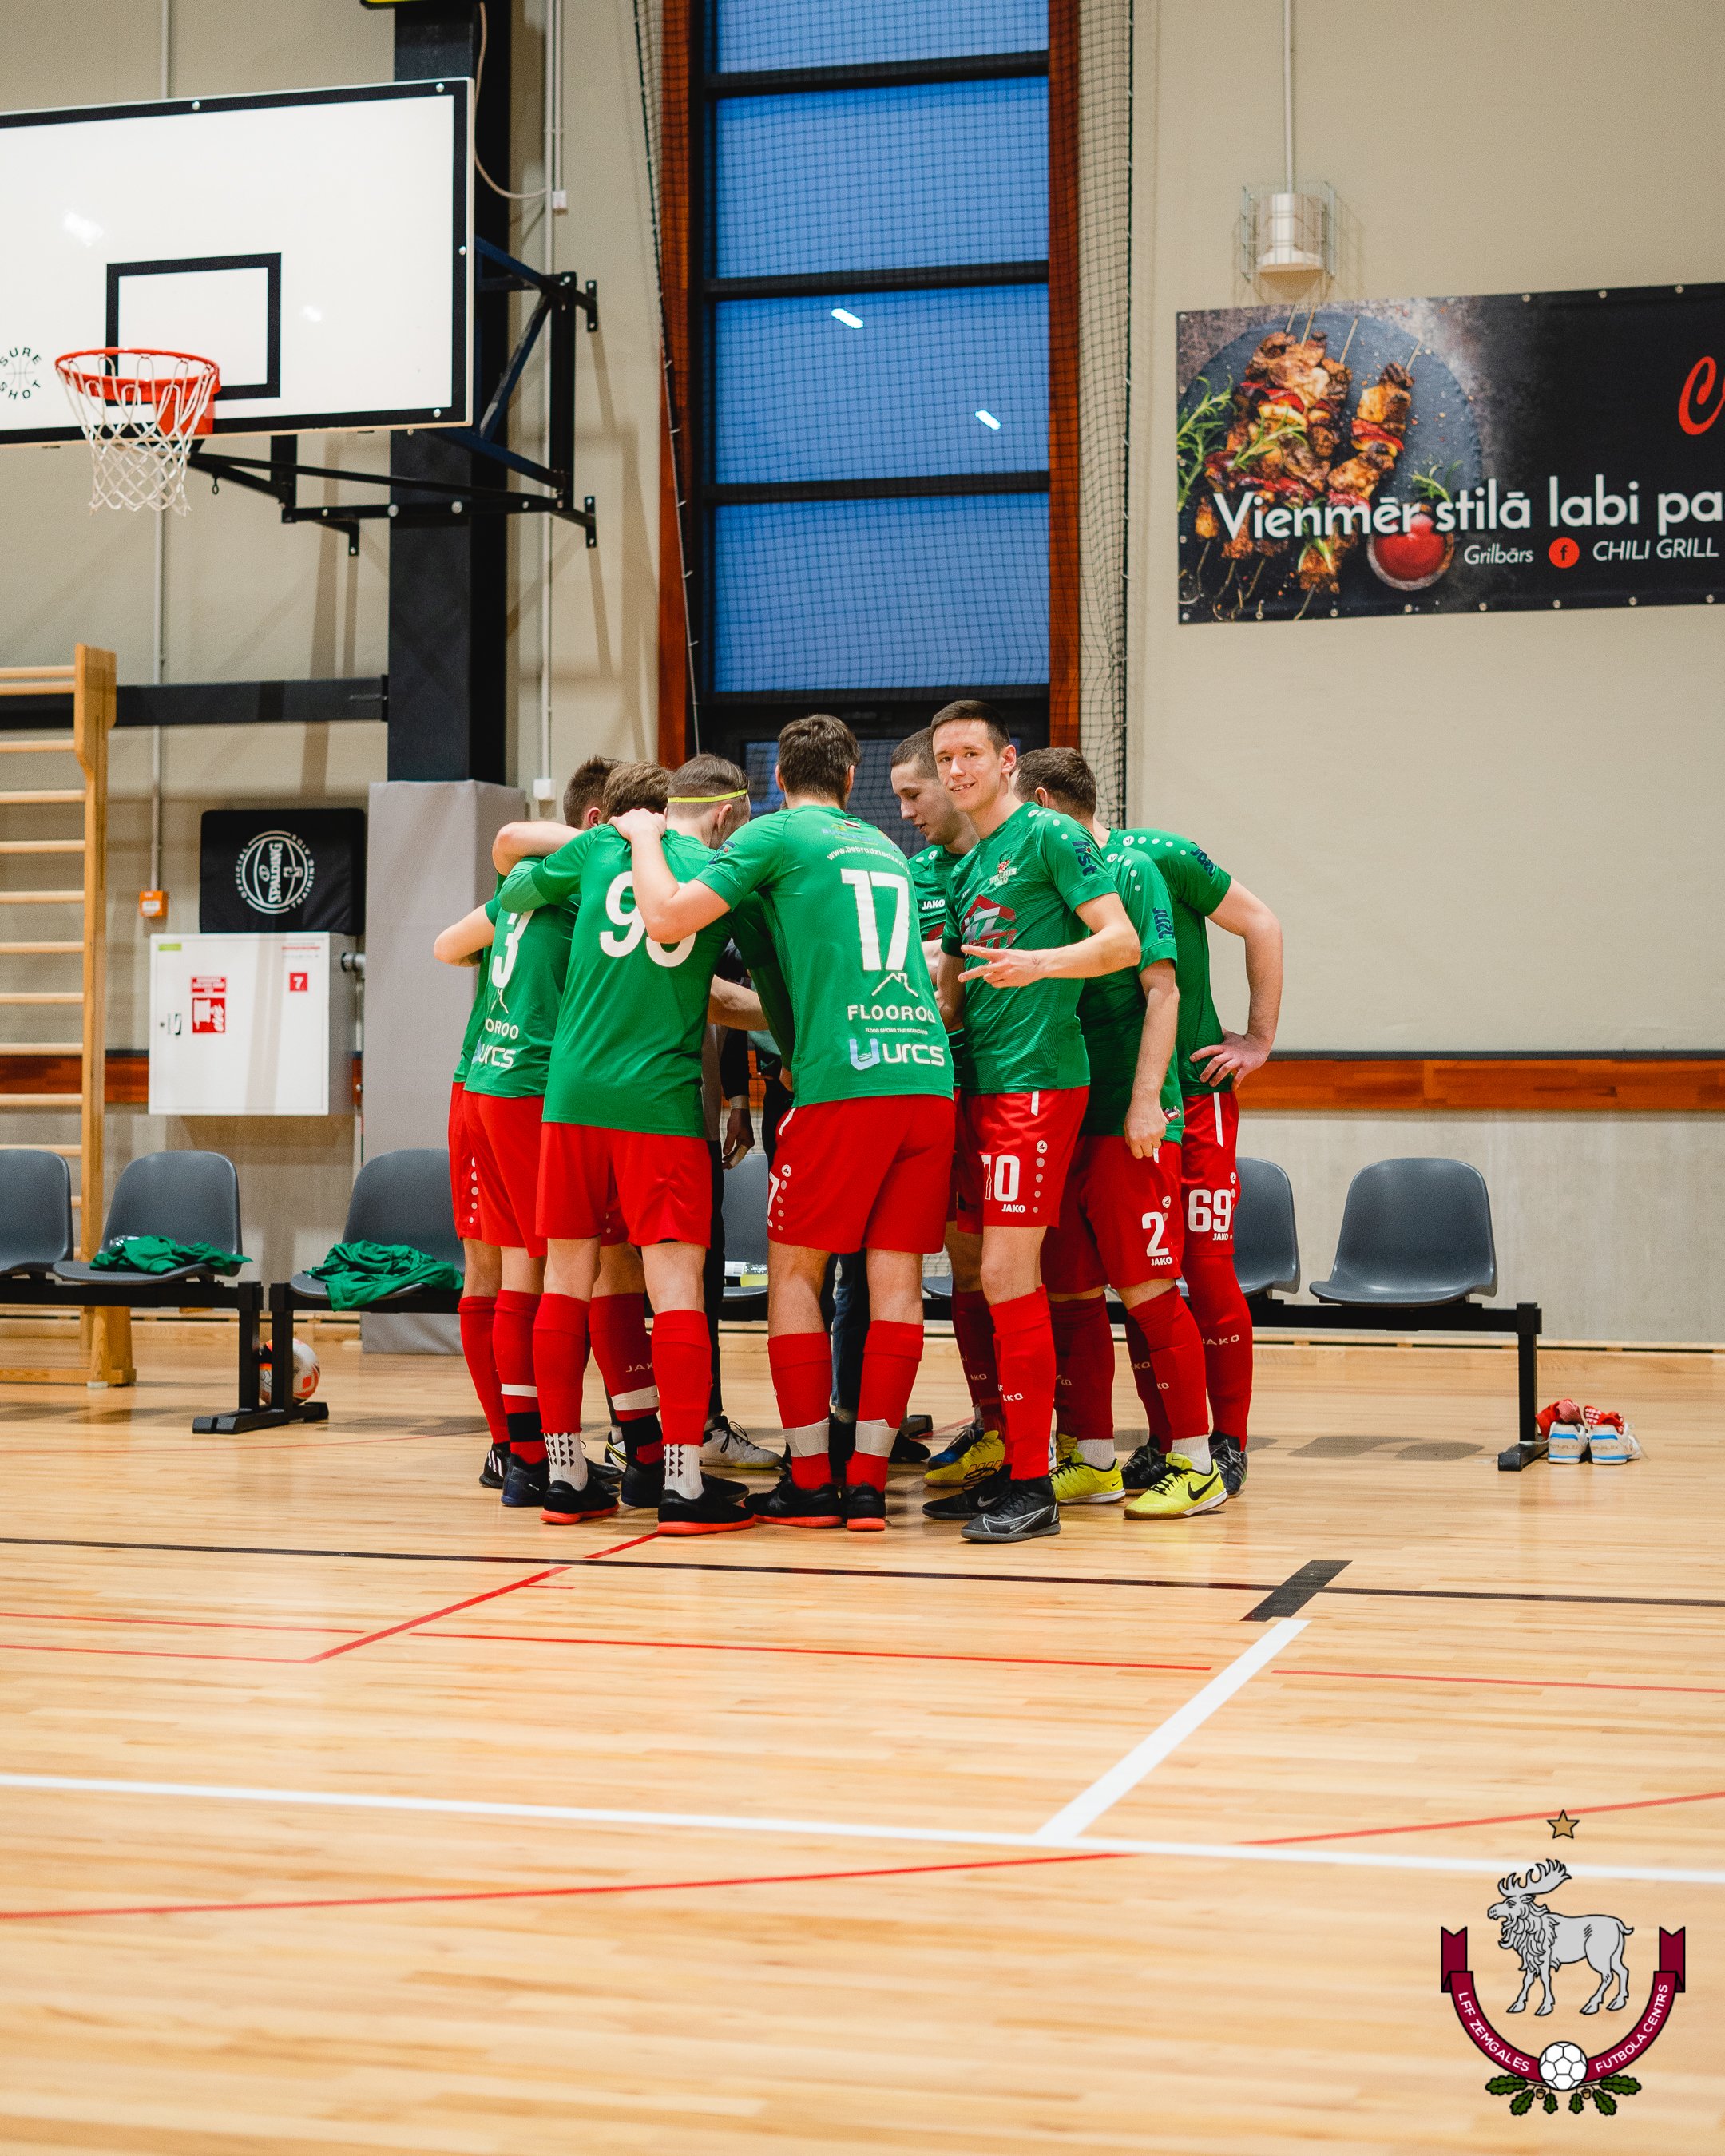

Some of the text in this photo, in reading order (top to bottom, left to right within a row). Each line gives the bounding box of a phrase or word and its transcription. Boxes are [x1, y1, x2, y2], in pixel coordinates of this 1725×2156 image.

[0, 347, 42, 367] SURE
[0, 382, 41, 400] SHOT
[1213, 474, 1723, 541] Vienmēr stilā labi pa
[1463, 543, 1534, 565] Grilbārs
[1592, 537, 1720, 561] CHILI GRILL
[1072, 841, 1097, 877] list
[268, 842, 284, 903] SPALDING
[922, 898, 946, 910] JAKO
[840, 868, 910, 971] 17
[293, 976, 303, 990] 7
[1001, 1203, 1026, 1214] JAKO
[1188, 1188, 1231, 1233] 69
[1141, 1211, 1169, 1258] 2
[1212, 1232, 1229, 1241] JAKO
[1151, 1257, 1173, 1266] JAKO
